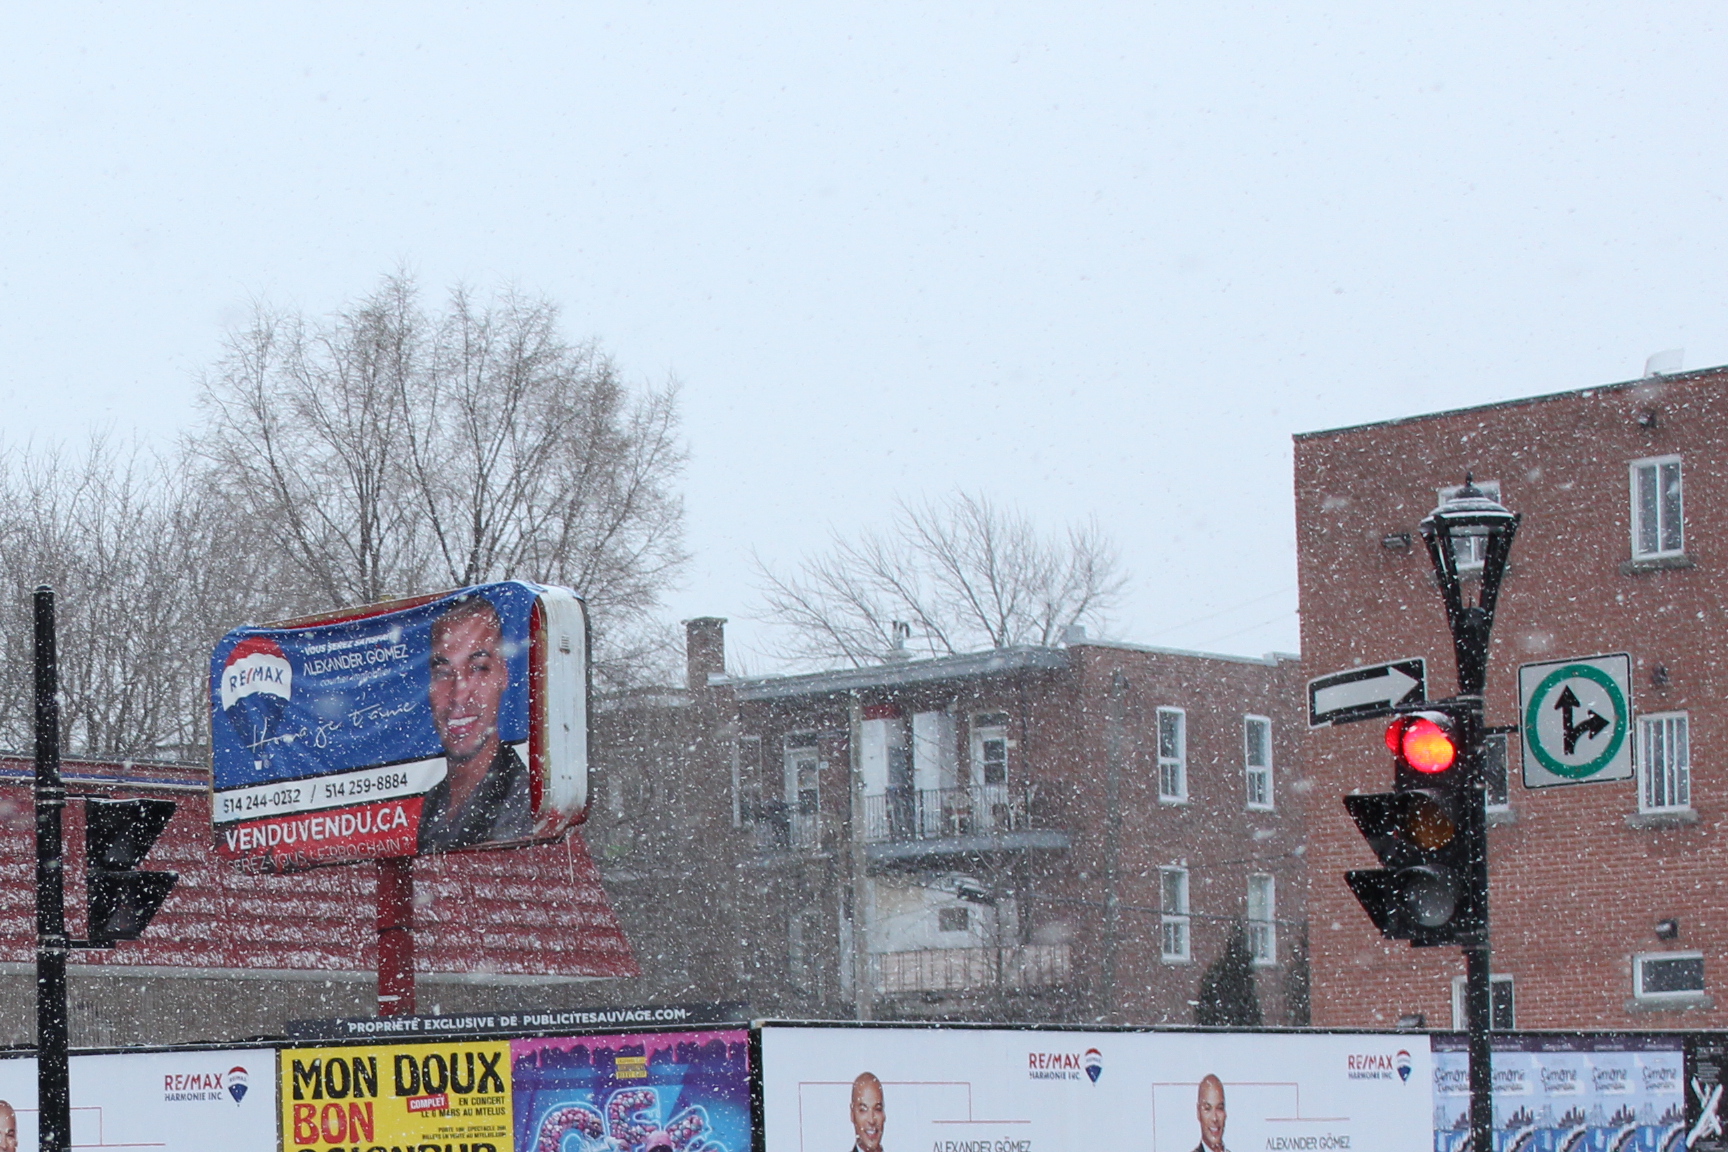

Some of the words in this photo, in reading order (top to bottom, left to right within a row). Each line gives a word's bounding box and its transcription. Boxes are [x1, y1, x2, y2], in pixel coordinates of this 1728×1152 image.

[304, 643, 326, 655] VOUS
[303, 654, 365, 676] ALEXANDER
[229, 666, 284, 692] RE/MAX
[223, 797, 242, 813] 514
[246, 789, 301, 810] 244-0232
[325, 782, 345, 798] 514
[348, 772, 408, 795] 259-8884
[225, 805, 409, 852] VENDUVENDU.CA
[424, 1016, 495, 1030] EXCLUSIVE
[501, 1016, 518, 1027] DE
[523, 1008, 686, 1026] PUBLICITESAUVAGE.COM
[1029, 1053, 1080, 1070] RE/MAX
[1348, 1055, 1393, 1070] RE/MAX
[164, 1073, 223, 1091] RE/MAX
[292, 1056, 378, 1100] MON
[394, 1052, 505, 1098] DOUX
[410, 1097, 445, 1110] COMPLET
[459, 1097, 469, 1106] EN
[471, 1096, 505, 1106] CONCERT
[439, 1108, 460, 1117] MARS
[463, 1108, 473, 1116] AU
[475, 1107, 506, 1116] MTELUS
[293, 1101, 375, 1145] BON
[1266, 1137, 1318, 1151] ALEXANDER
